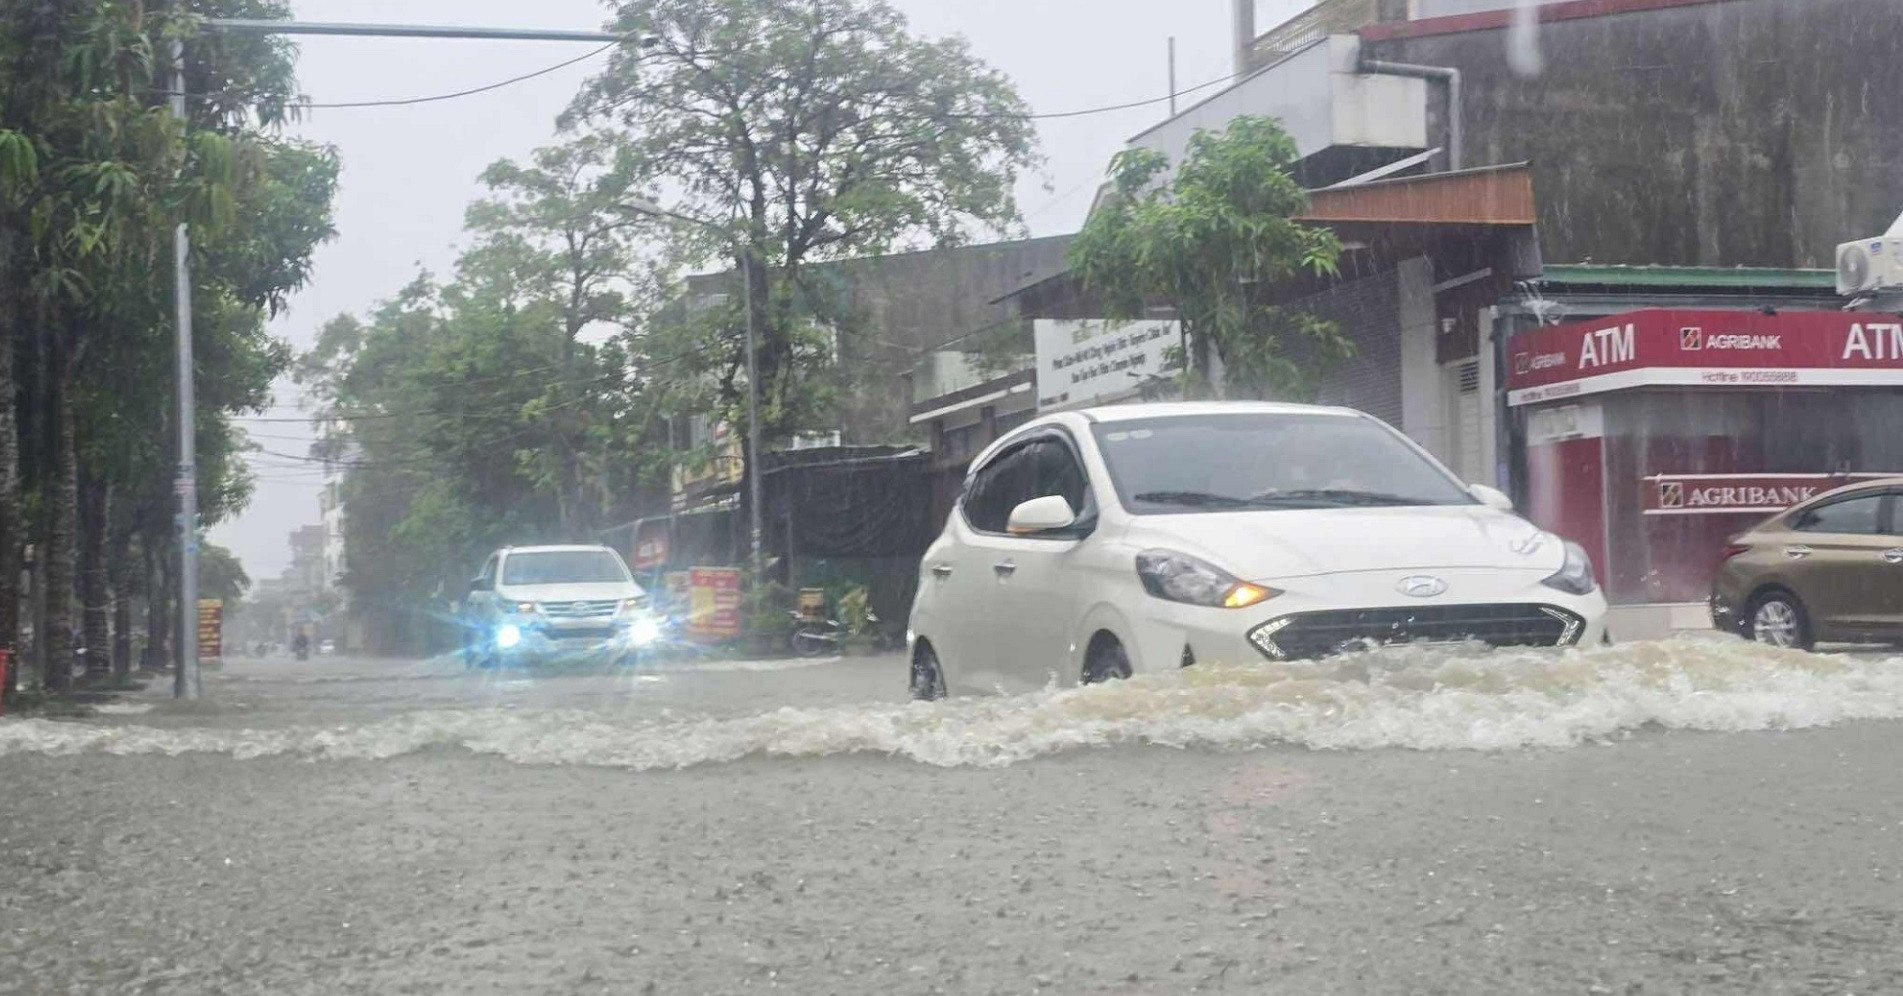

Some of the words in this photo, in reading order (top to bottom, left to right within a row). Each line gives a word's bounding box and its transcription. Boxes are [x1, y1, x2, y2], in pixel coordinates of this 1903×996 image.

[1578, 322, 1635, 369] ATM
[1705, 334, 1782, 350] AGRIBANK
[1686, 486, 1817, 506] AGRIBANK
